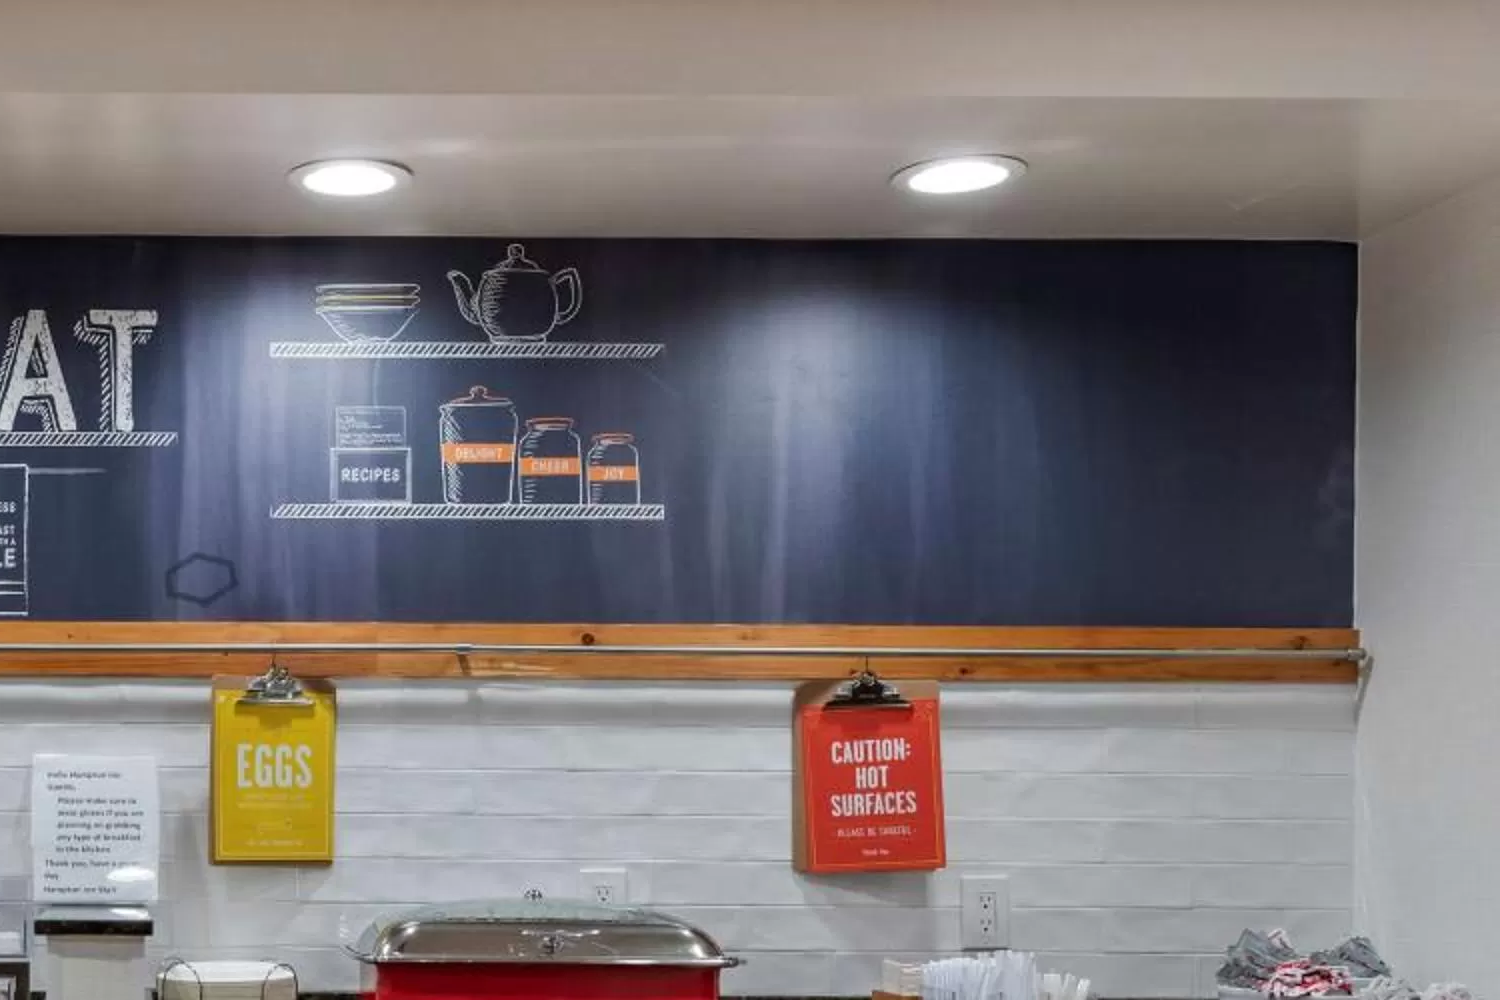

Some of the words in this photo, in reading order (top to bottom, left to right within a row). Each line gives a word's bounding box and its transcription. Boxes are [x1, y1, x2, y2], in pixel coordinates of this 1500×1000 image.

[341, 467, 400, 483] RECIPES
[603, 467, 624, 481] JOY
[831, 737, 911, 765] CAUTION:
[236, 743, 313, 789] EGGS
[855, 765, 889, 789] HOT
[831, 791, 917, 817] SURFACES
